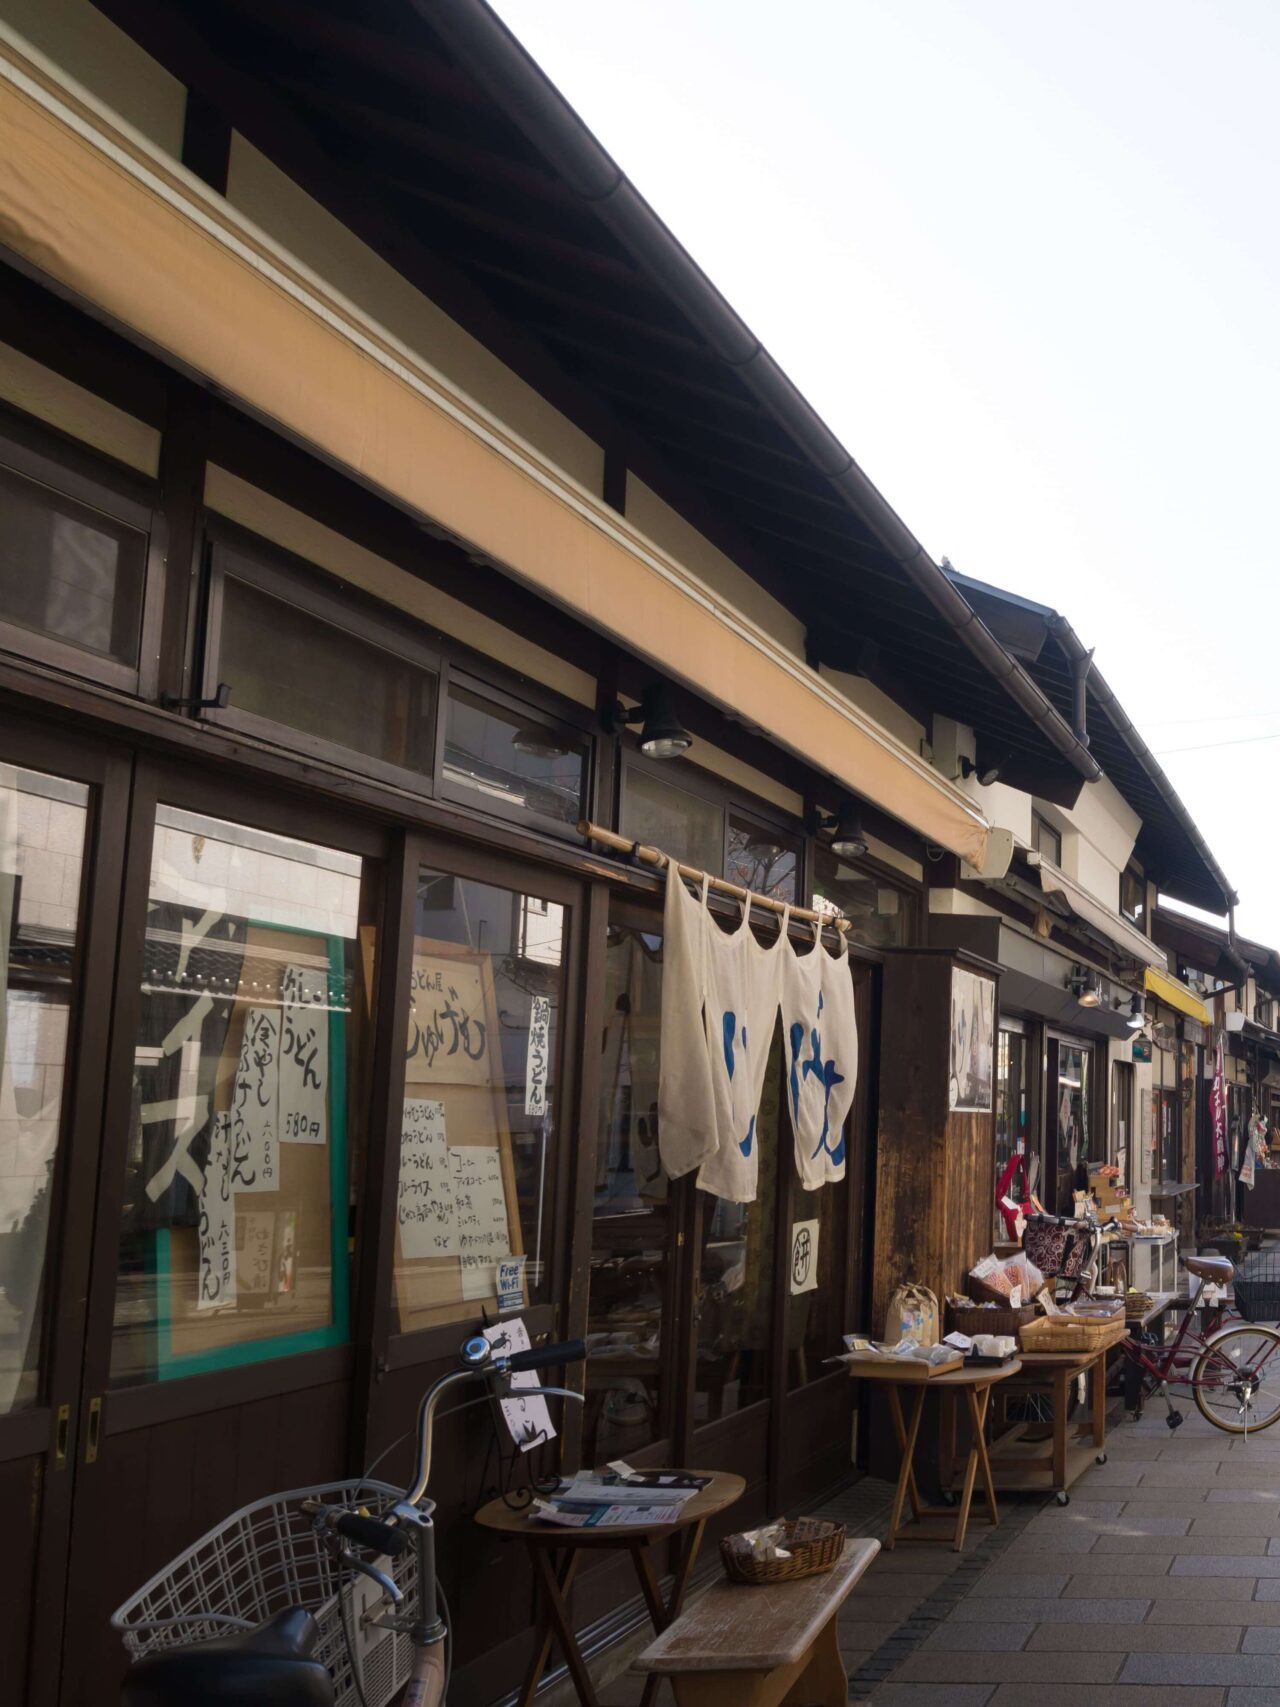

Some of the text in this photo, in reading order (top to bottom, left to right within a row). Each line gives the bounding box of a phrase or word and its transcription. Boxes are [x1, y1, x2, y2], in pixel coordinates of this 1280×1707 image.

[251, 1014, 276, 1107] 冷やし
[285, 1112, 320, 1138] 580円
[500, 1263, 518, 1278] Free
[500, 1276, 518, 1291] Wi-Fi
